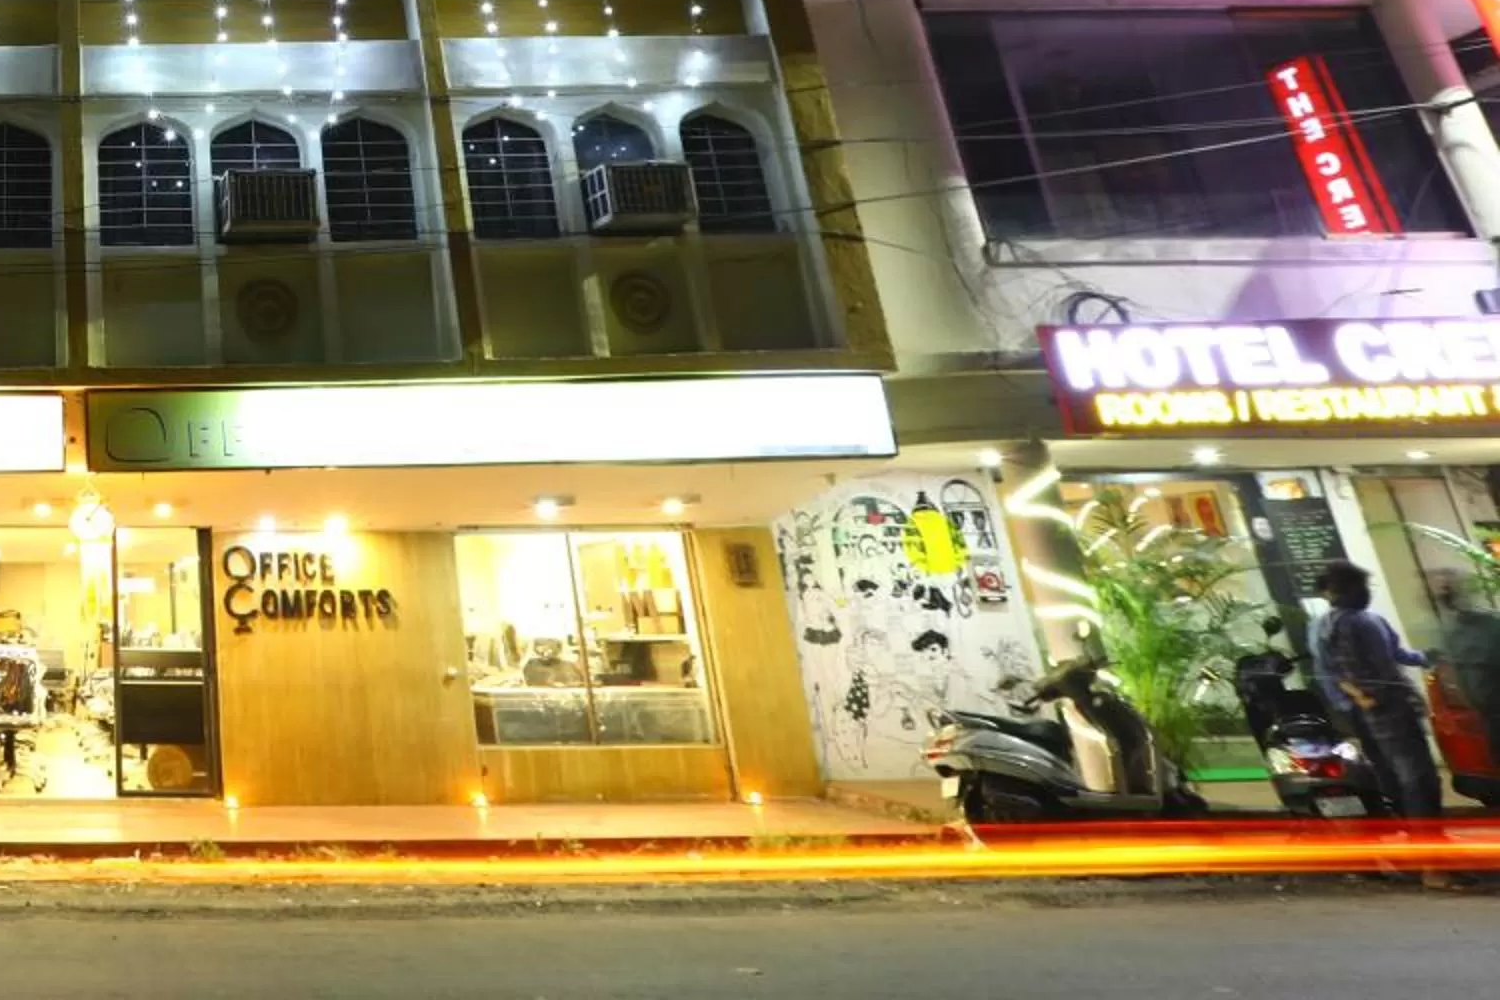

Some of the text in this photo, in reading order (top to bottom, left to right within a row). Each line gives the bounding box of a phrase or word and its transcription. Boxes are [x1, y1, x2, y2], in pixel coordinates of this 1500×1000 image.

[1055, 321, 1500, 390] HOTEL CRE
[1094, 391, 1234, 425] ROOMS
[1250, 384, 1488, 421] RESTAURANT
[222, 545, 335, 585] OFFICE
[223, 584, 393, 622] COMFORTS
